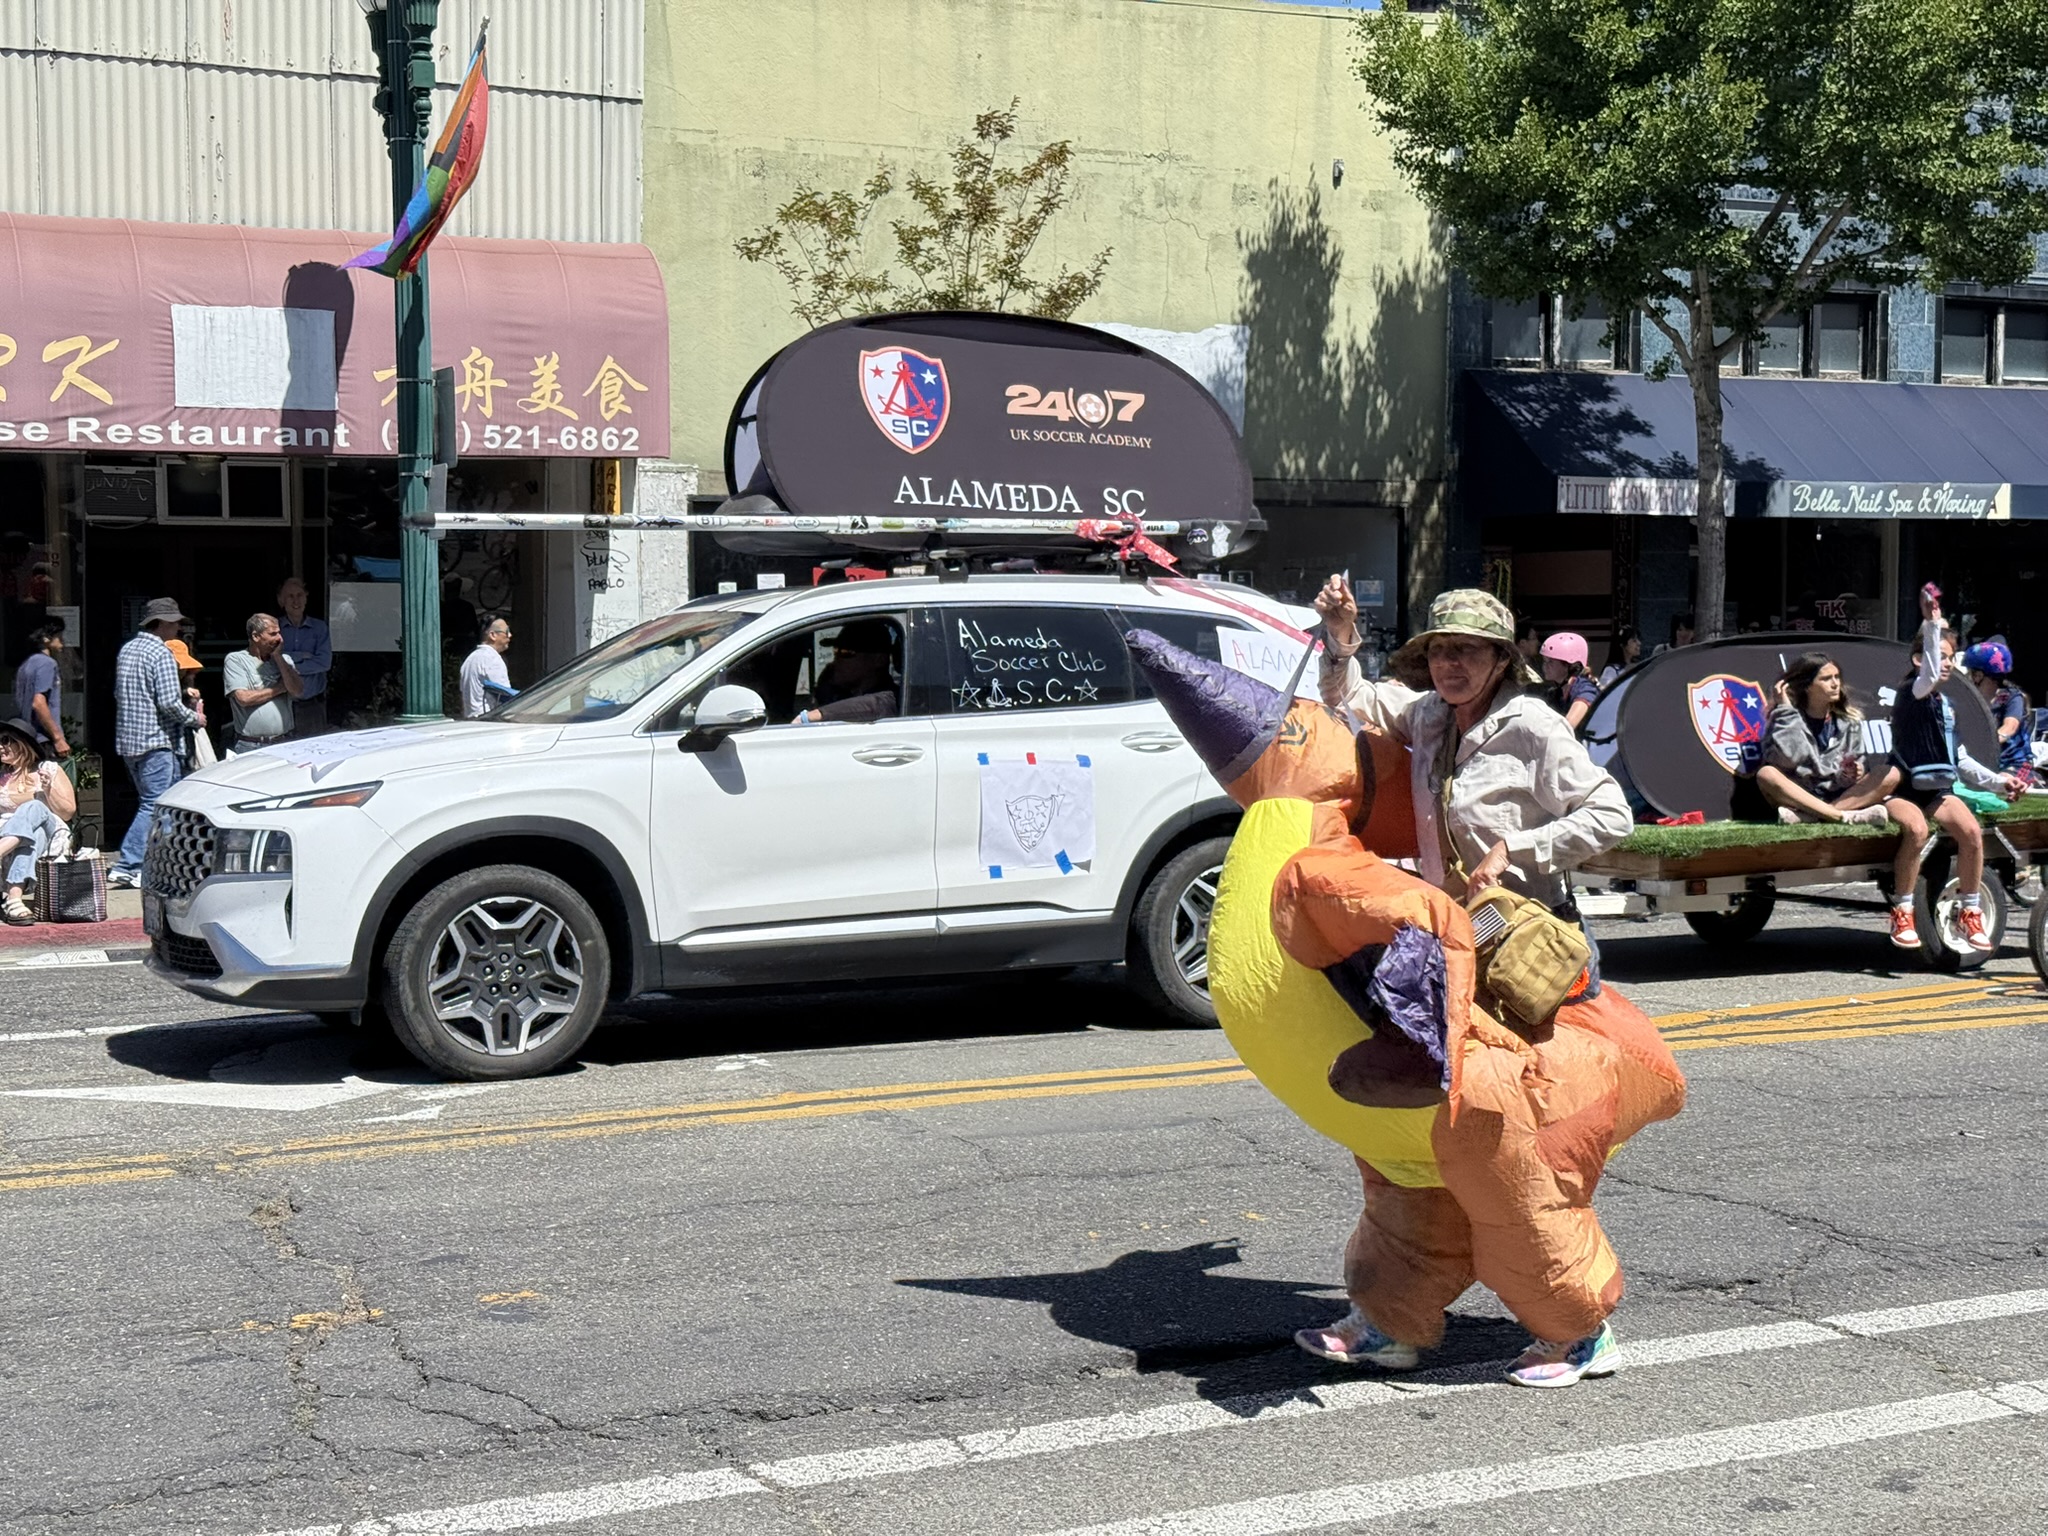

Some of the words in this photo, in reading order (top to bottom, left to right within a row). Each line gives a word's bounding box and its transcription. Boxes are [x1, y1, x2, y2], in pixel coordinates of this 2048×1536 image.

[68, 417, 350, 447] Restaurant
[483, 425, 640, 451] 521-6862
[892, 419, 930, 437] SC
[1010, 429, 1031, 441] UK
[1033, 430, 1086, 444] SOCCER
[1089, 433, 1152, 449] ACADEMY
[894, 475, 1083, 514] ALAMEDA
[1103, 487, 1147, 517] SC
[1793, 484, 1841, 512] Bella
[1842, 485, 1882, 514] Nail
[1885, 489, 1914, 517] Spa
[1917, 487, 1931, 512] &
[1933, 487, 1987, 518] Waxing
[1815, 600, 1847, 618] TK
[957, 618, 1063, 650] Alameda
[972, 649, 1050, 673] Soccer
[1058, 651, 1107, 672] Club
[1232, 639, 1319, 675] ALAM
